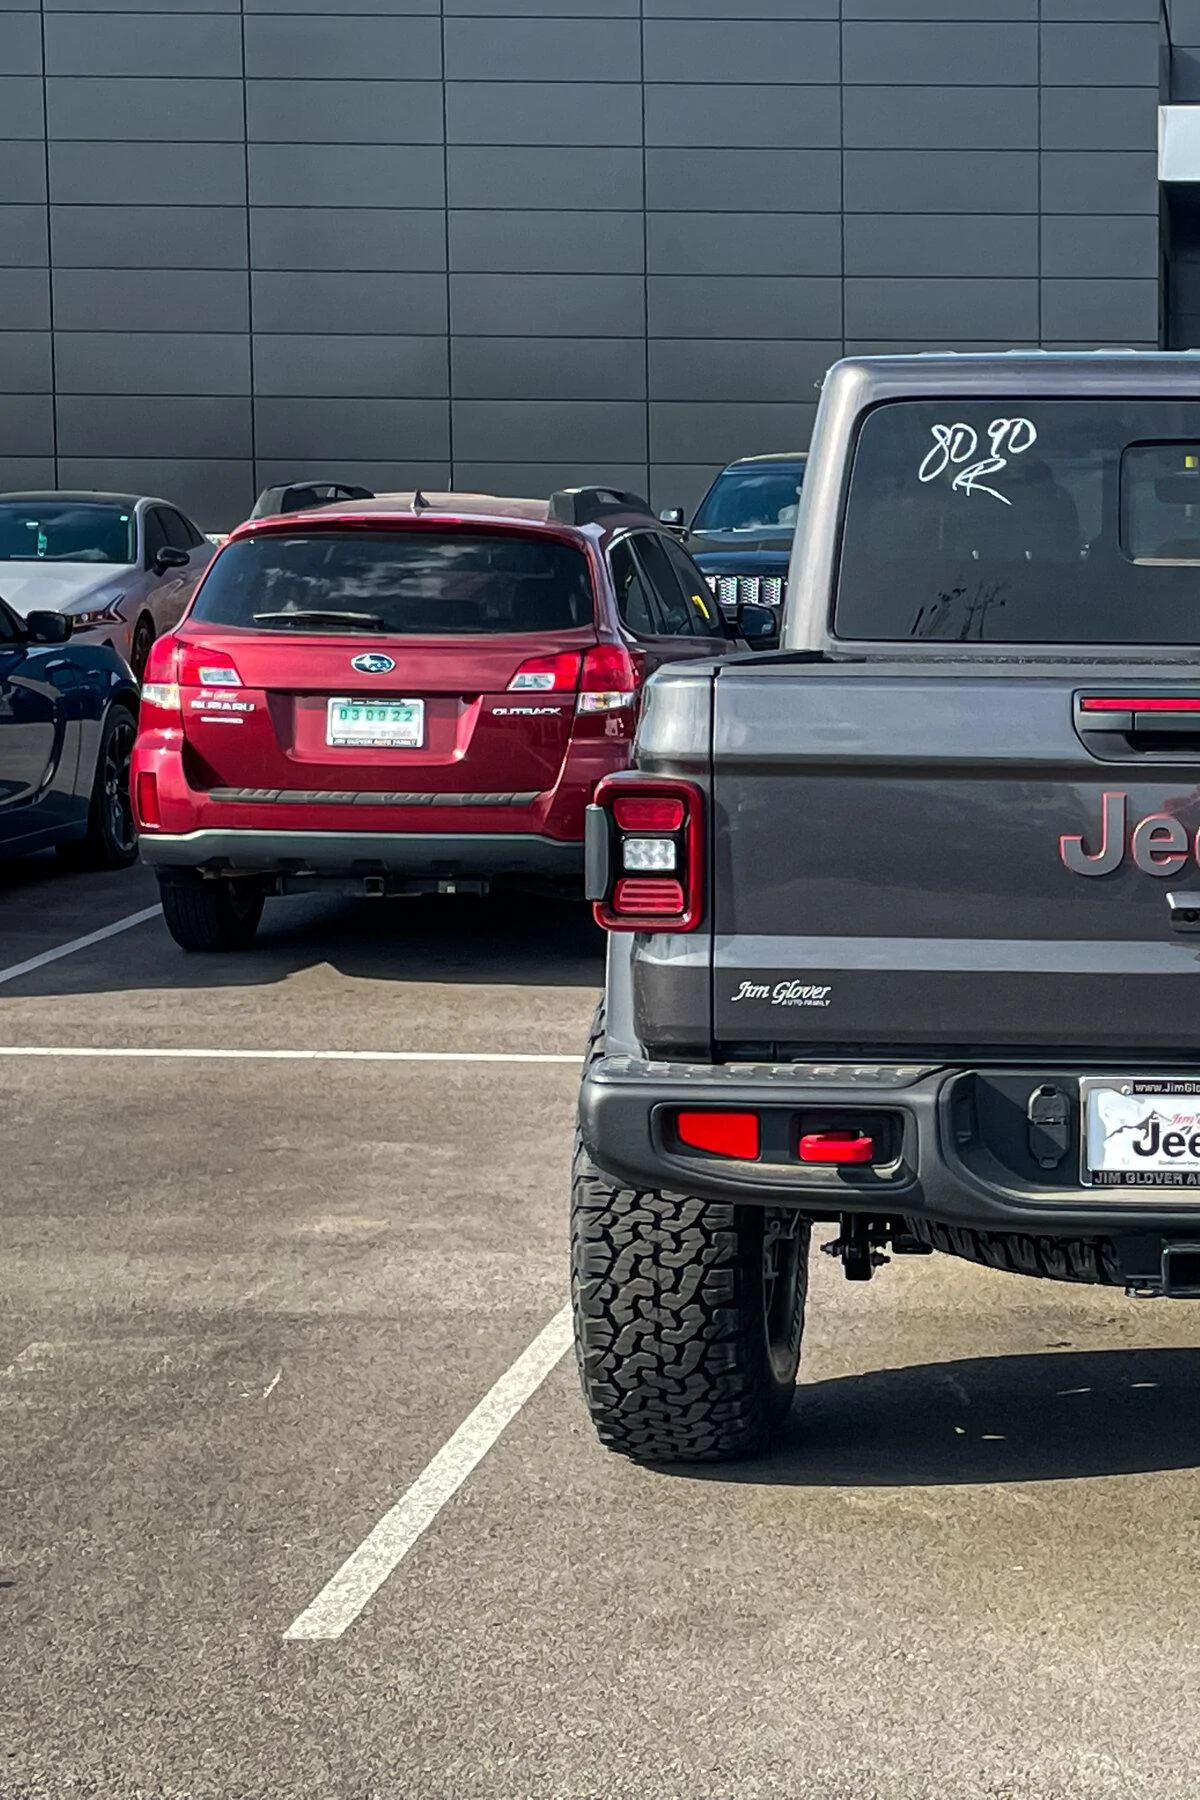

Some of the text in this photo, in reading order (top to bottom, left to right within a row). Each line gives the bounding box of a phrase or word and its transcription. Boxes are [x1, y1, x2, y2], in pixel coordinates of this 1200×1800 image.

[492, 707, 563, 716] OUTBACK
[731, 979, 832, 1004] Jim Glover
[1171, 1113, 1195, 1126] Jim
[1095, 1172, 1121, 1184] JIM
[1126, 1172, 1184, 1185] GLOVER
